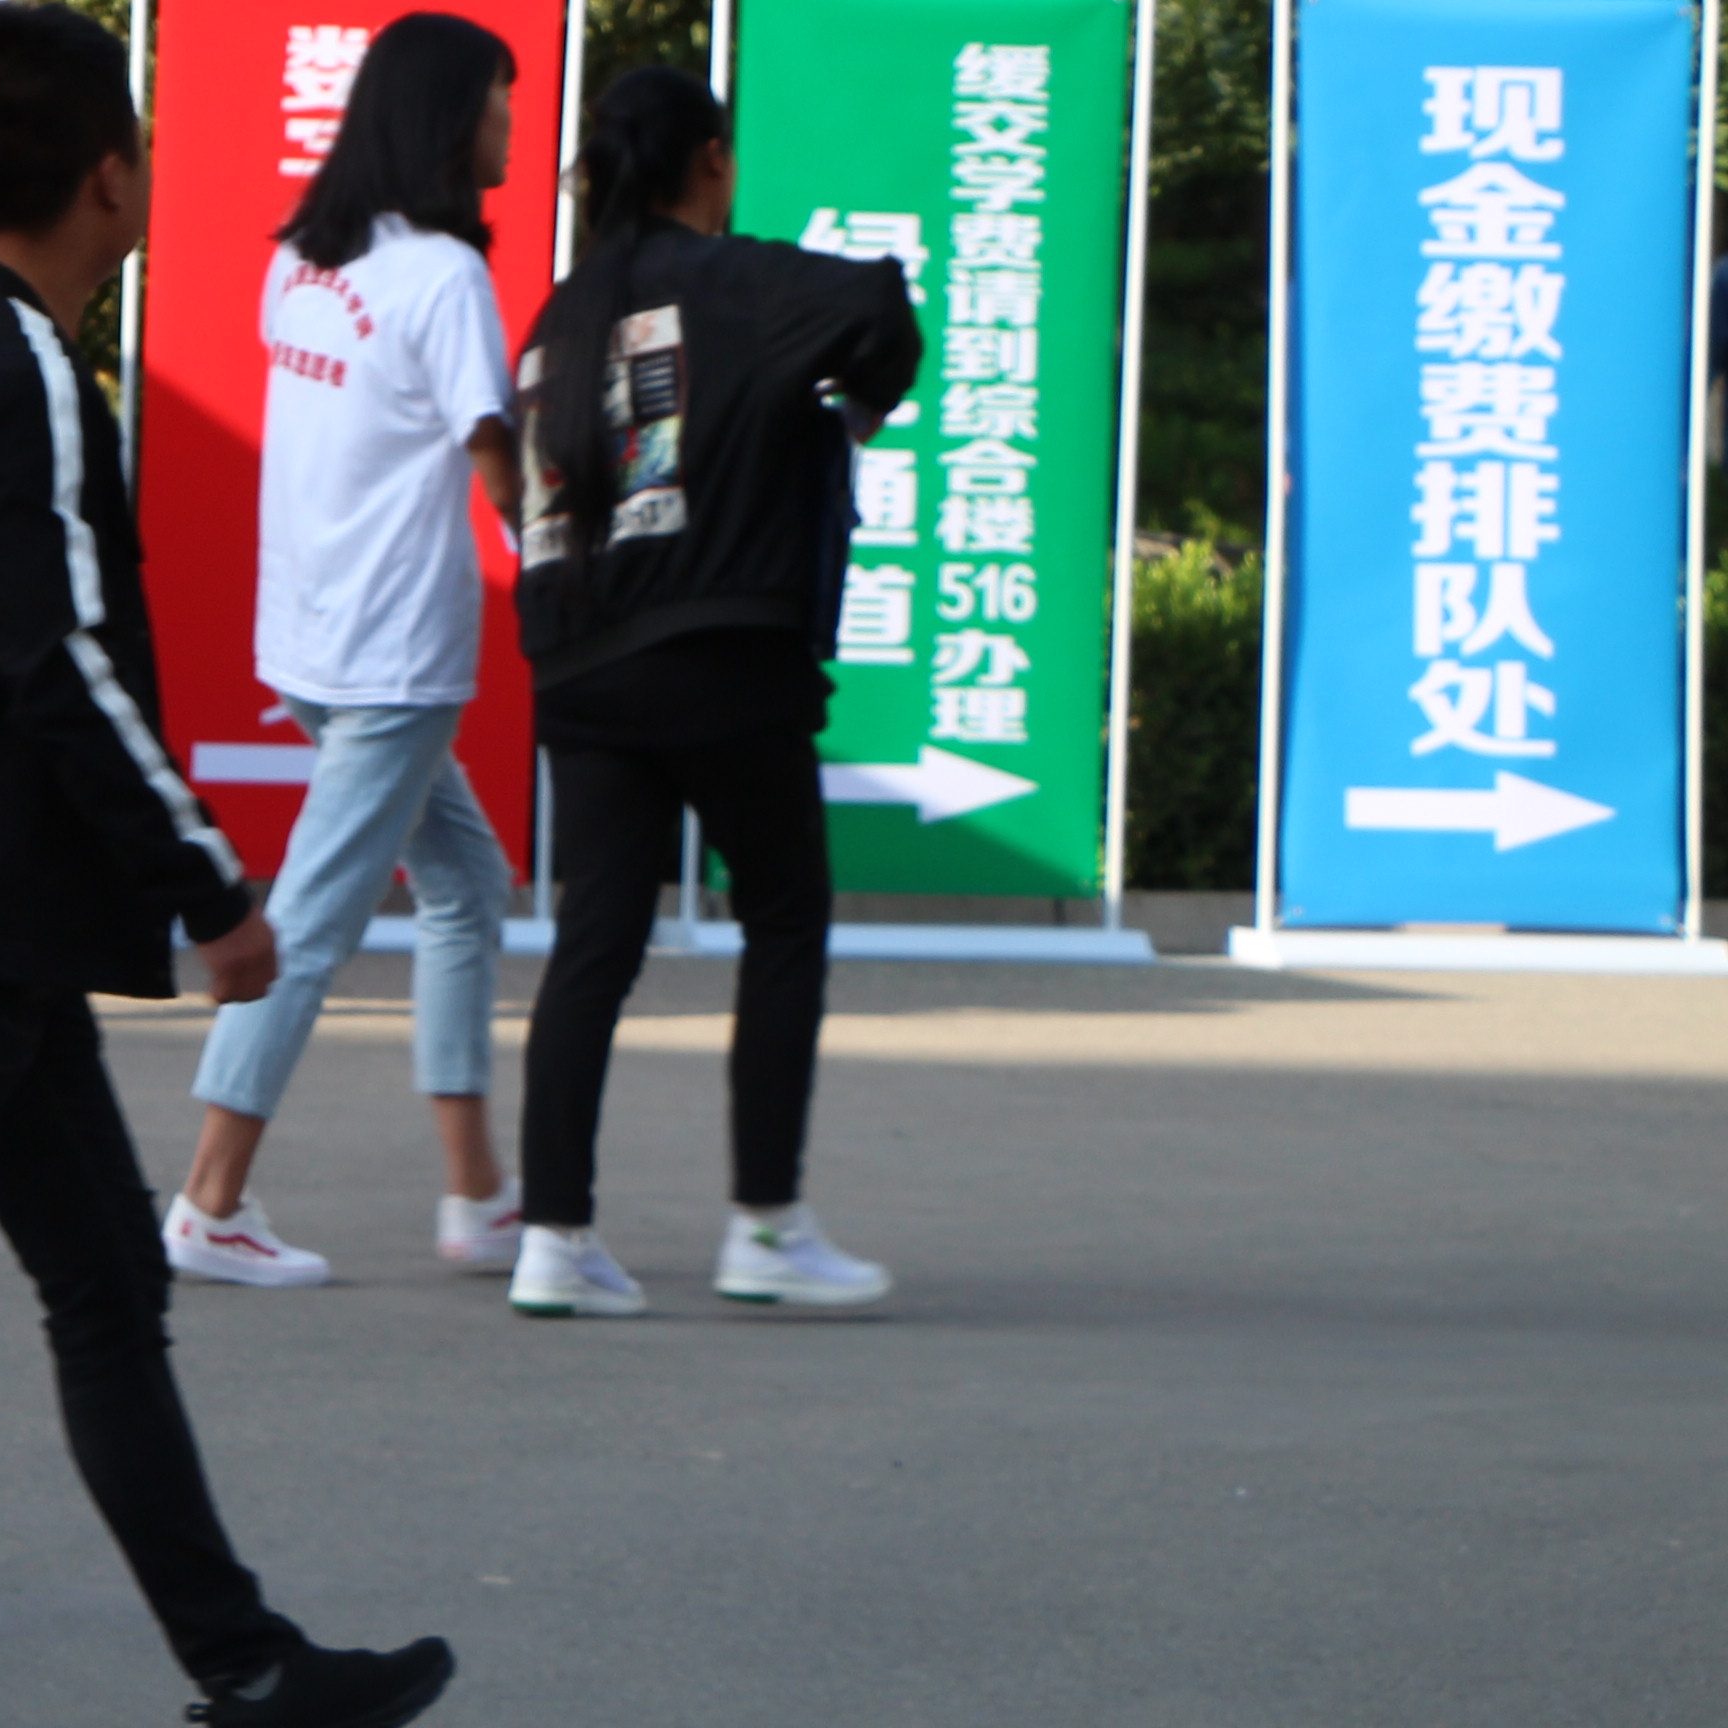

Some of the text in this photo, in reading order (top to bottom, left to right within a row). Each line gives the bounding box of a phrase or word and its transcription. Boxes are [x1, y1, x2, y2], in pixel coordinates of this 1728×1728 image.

[1409, 66, 1566, 758] 现金缴费排队处
